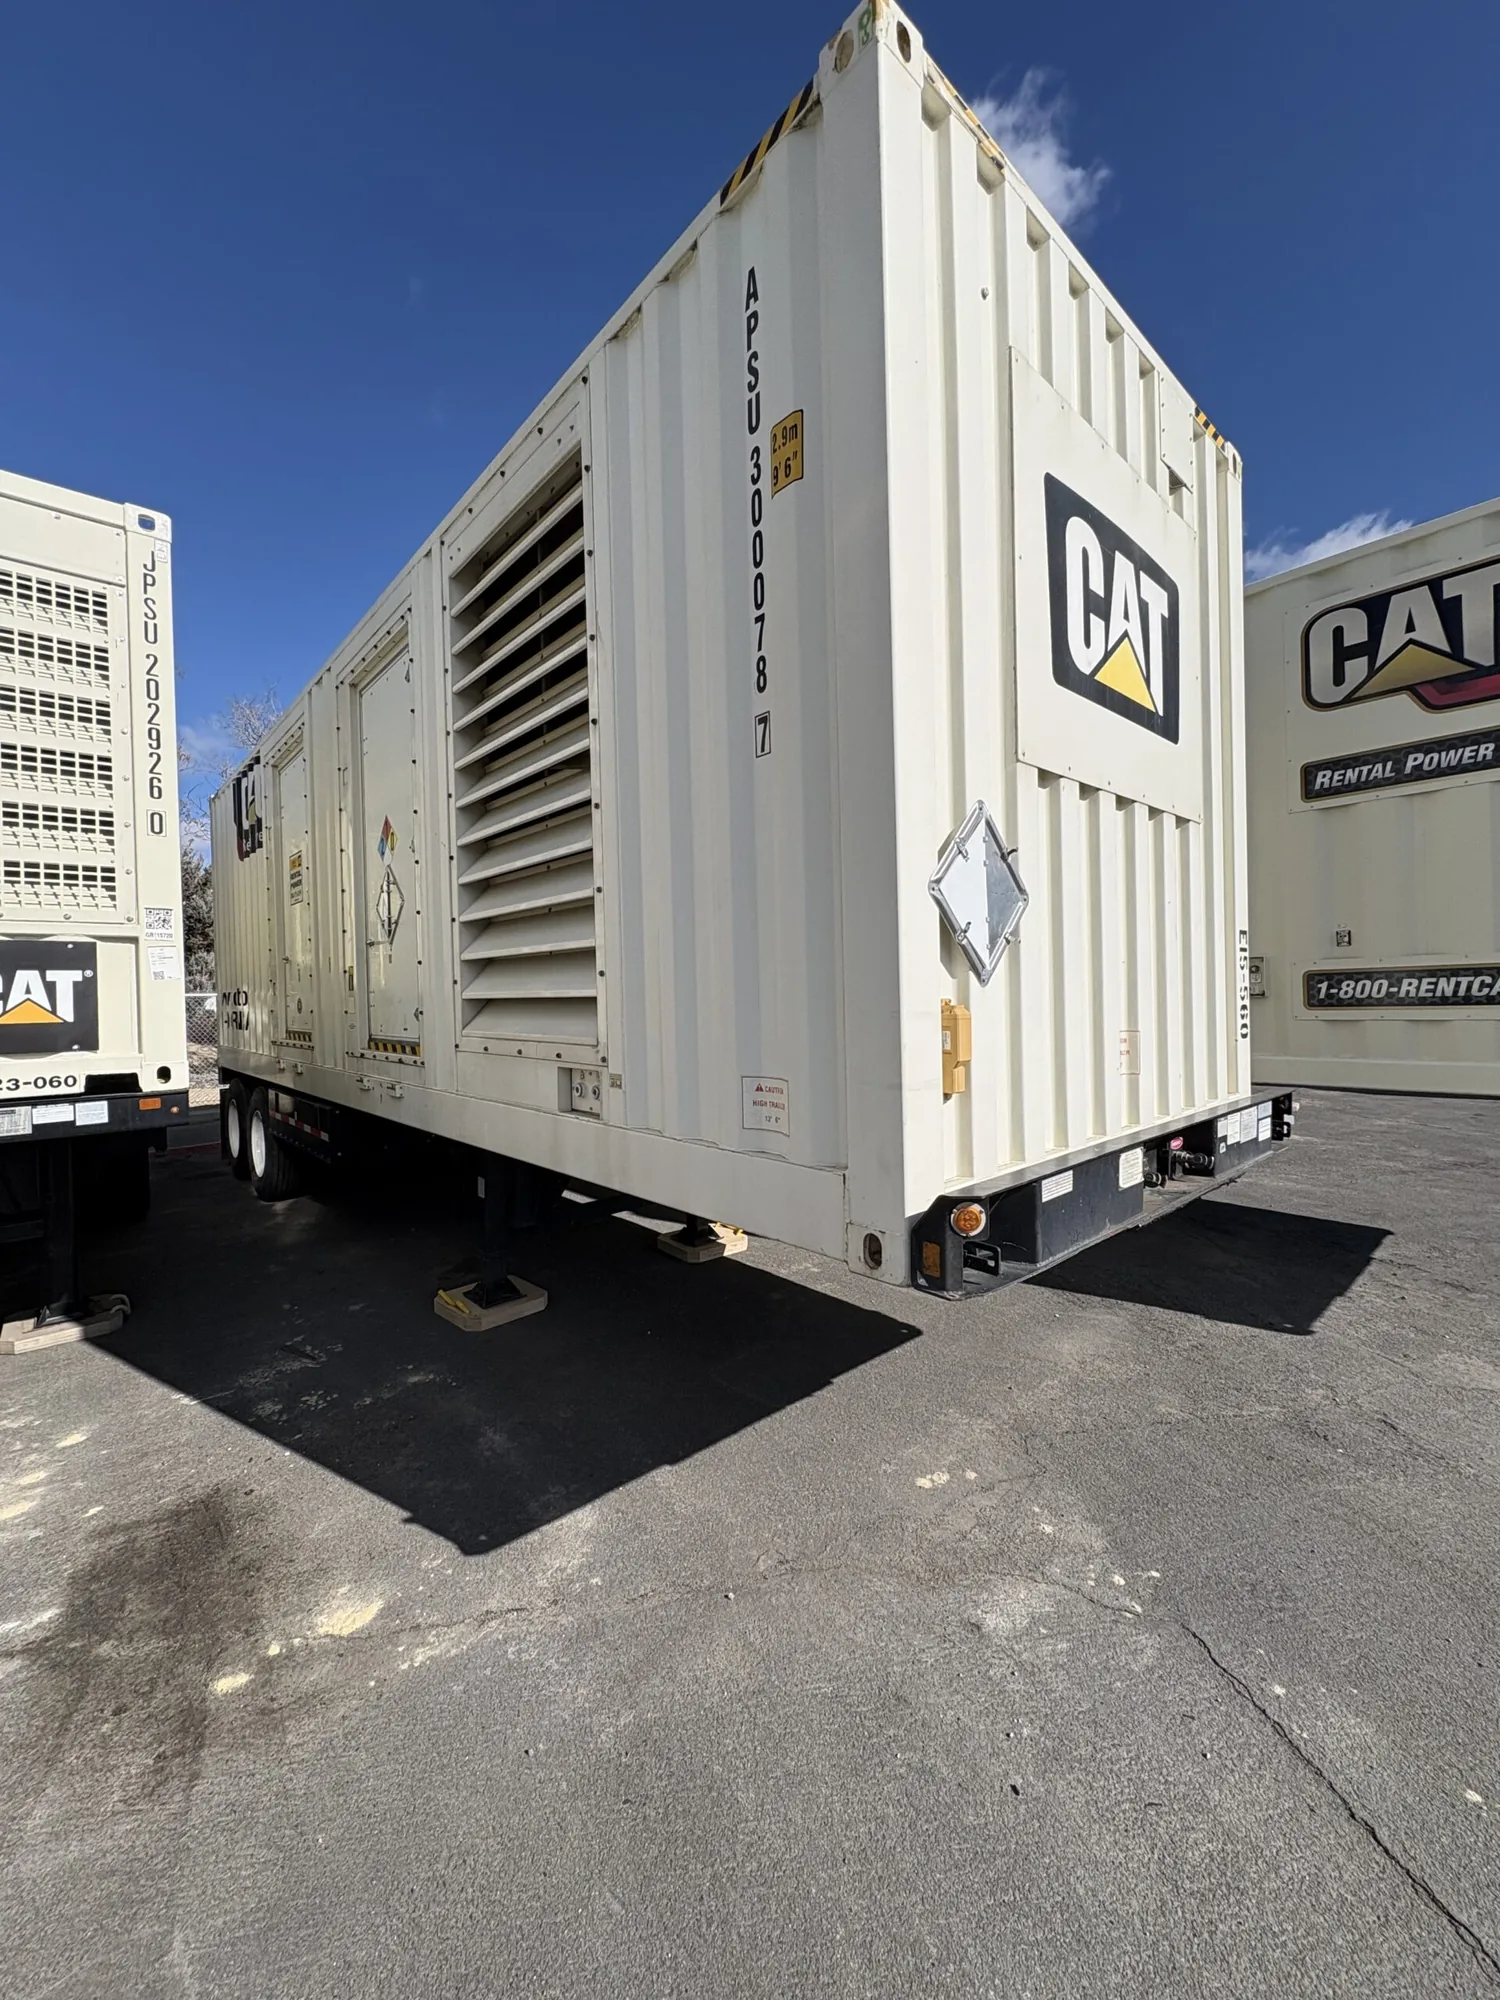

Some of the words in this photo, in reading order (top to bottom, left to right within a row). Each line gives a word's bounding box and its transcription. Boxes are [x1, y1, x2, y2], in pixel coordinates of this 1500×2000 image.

[745, 266, 761, 435] APSU
[772, 423, 798, 455] 2.9m
[143, 550, 158, 644] JPSU
[751, 445, 769, 693] 300078
[1065, 516, 1169, 717] CAT
[1309, 562, 1500, 704] CAT
[145, 654, 164, 800] 202926
[758, 715, 768, 753] 7
[1314, 760, 1396, 790] RENTAL
[1404, 742, 1496, 775] POWER
[150, 812, 163, 834] 0
[0, 970, 83, 1022] AT
[0, 1074, 77, 1091] 3-060
